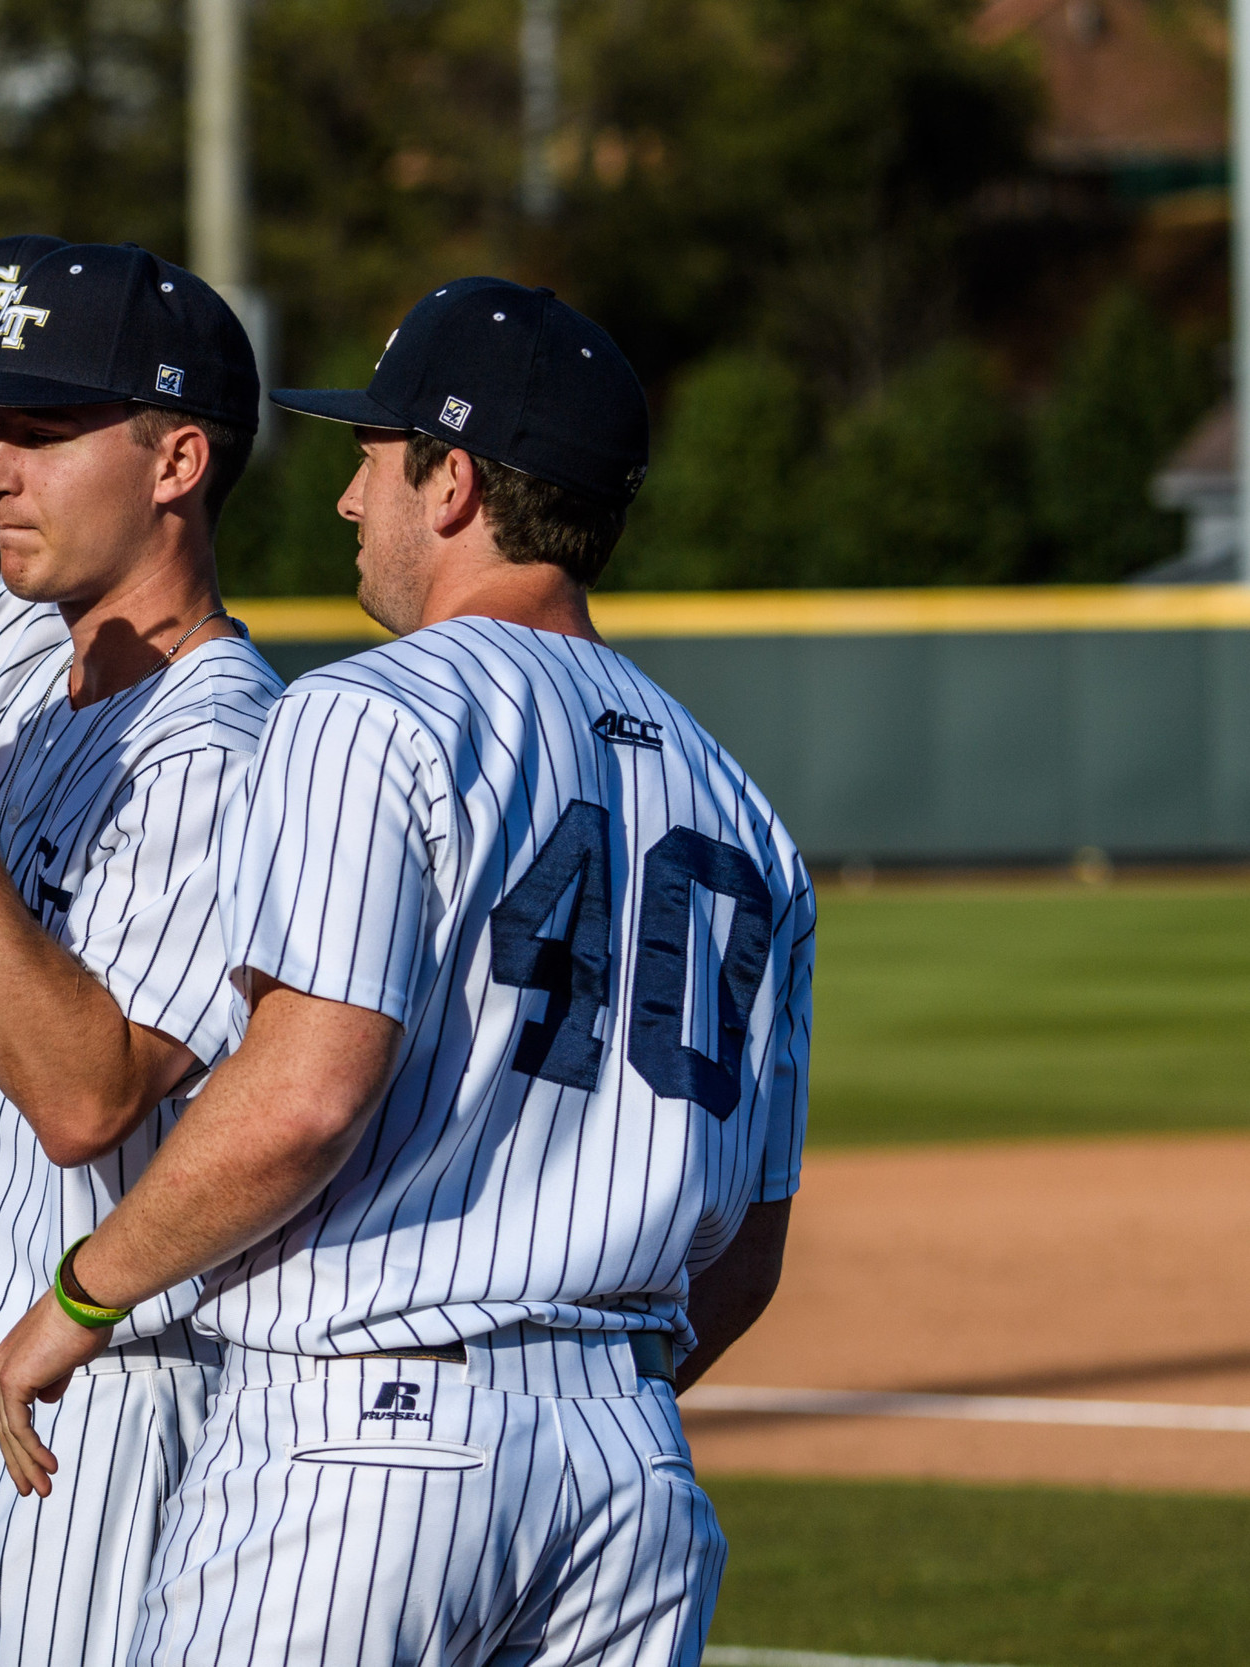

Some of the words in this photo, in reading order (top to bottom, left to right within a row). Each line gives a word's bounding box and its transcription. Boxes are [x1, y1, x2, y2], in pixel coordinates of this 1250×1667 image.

[592, 709, 664, 750] ACC
[490, 798, 772, 1121] 40
[362, 1410, 432, 1422] RUSSELL
